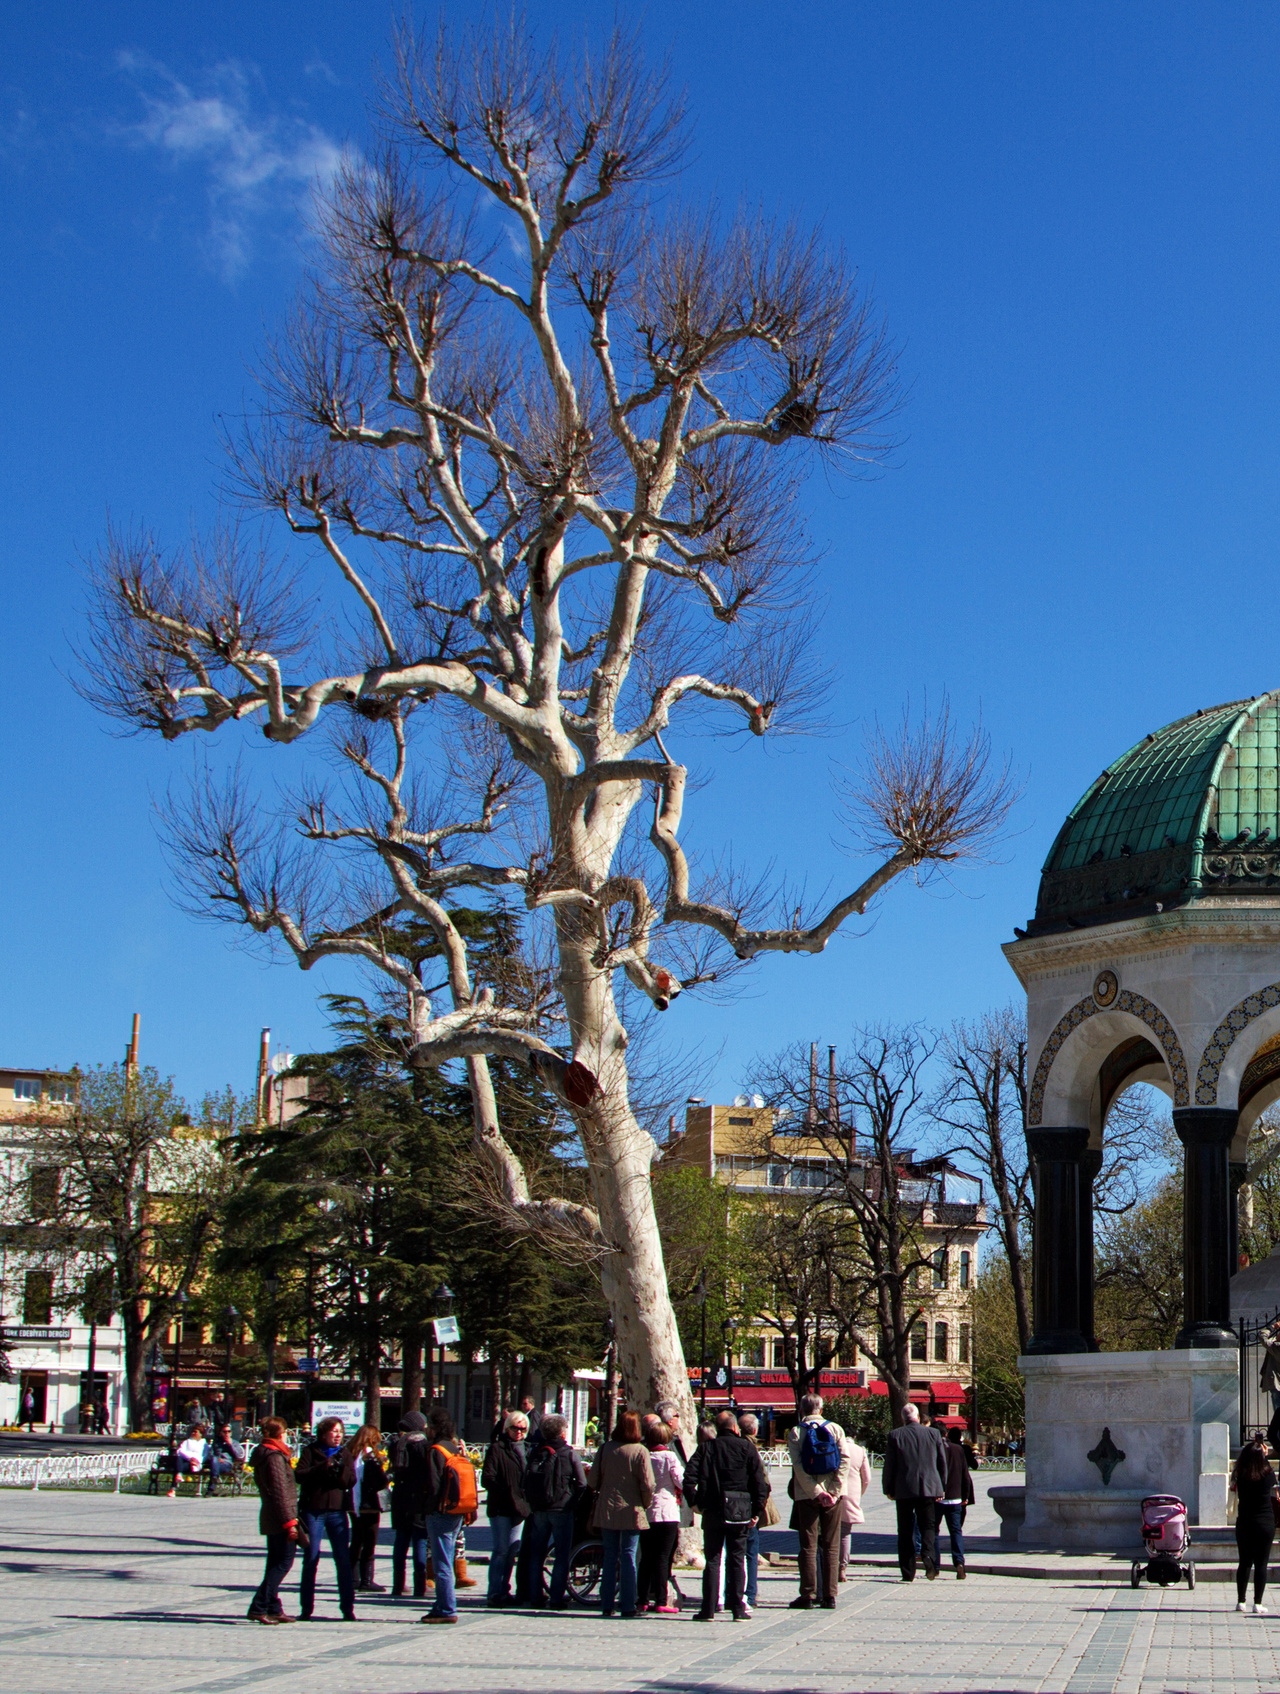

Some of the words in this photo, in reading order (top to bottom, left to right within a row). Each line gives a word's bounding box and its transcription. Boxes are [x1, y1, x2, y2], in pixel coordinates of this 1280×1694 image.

[3, 1329, 18, 1337] TÜRK
[19, 1329, 48, 1338] EDEBİYATI
[48, 1330, 70, 1338] DERGİSİ
[820, 1371, 859, 1384] KÖFTECİSİ
